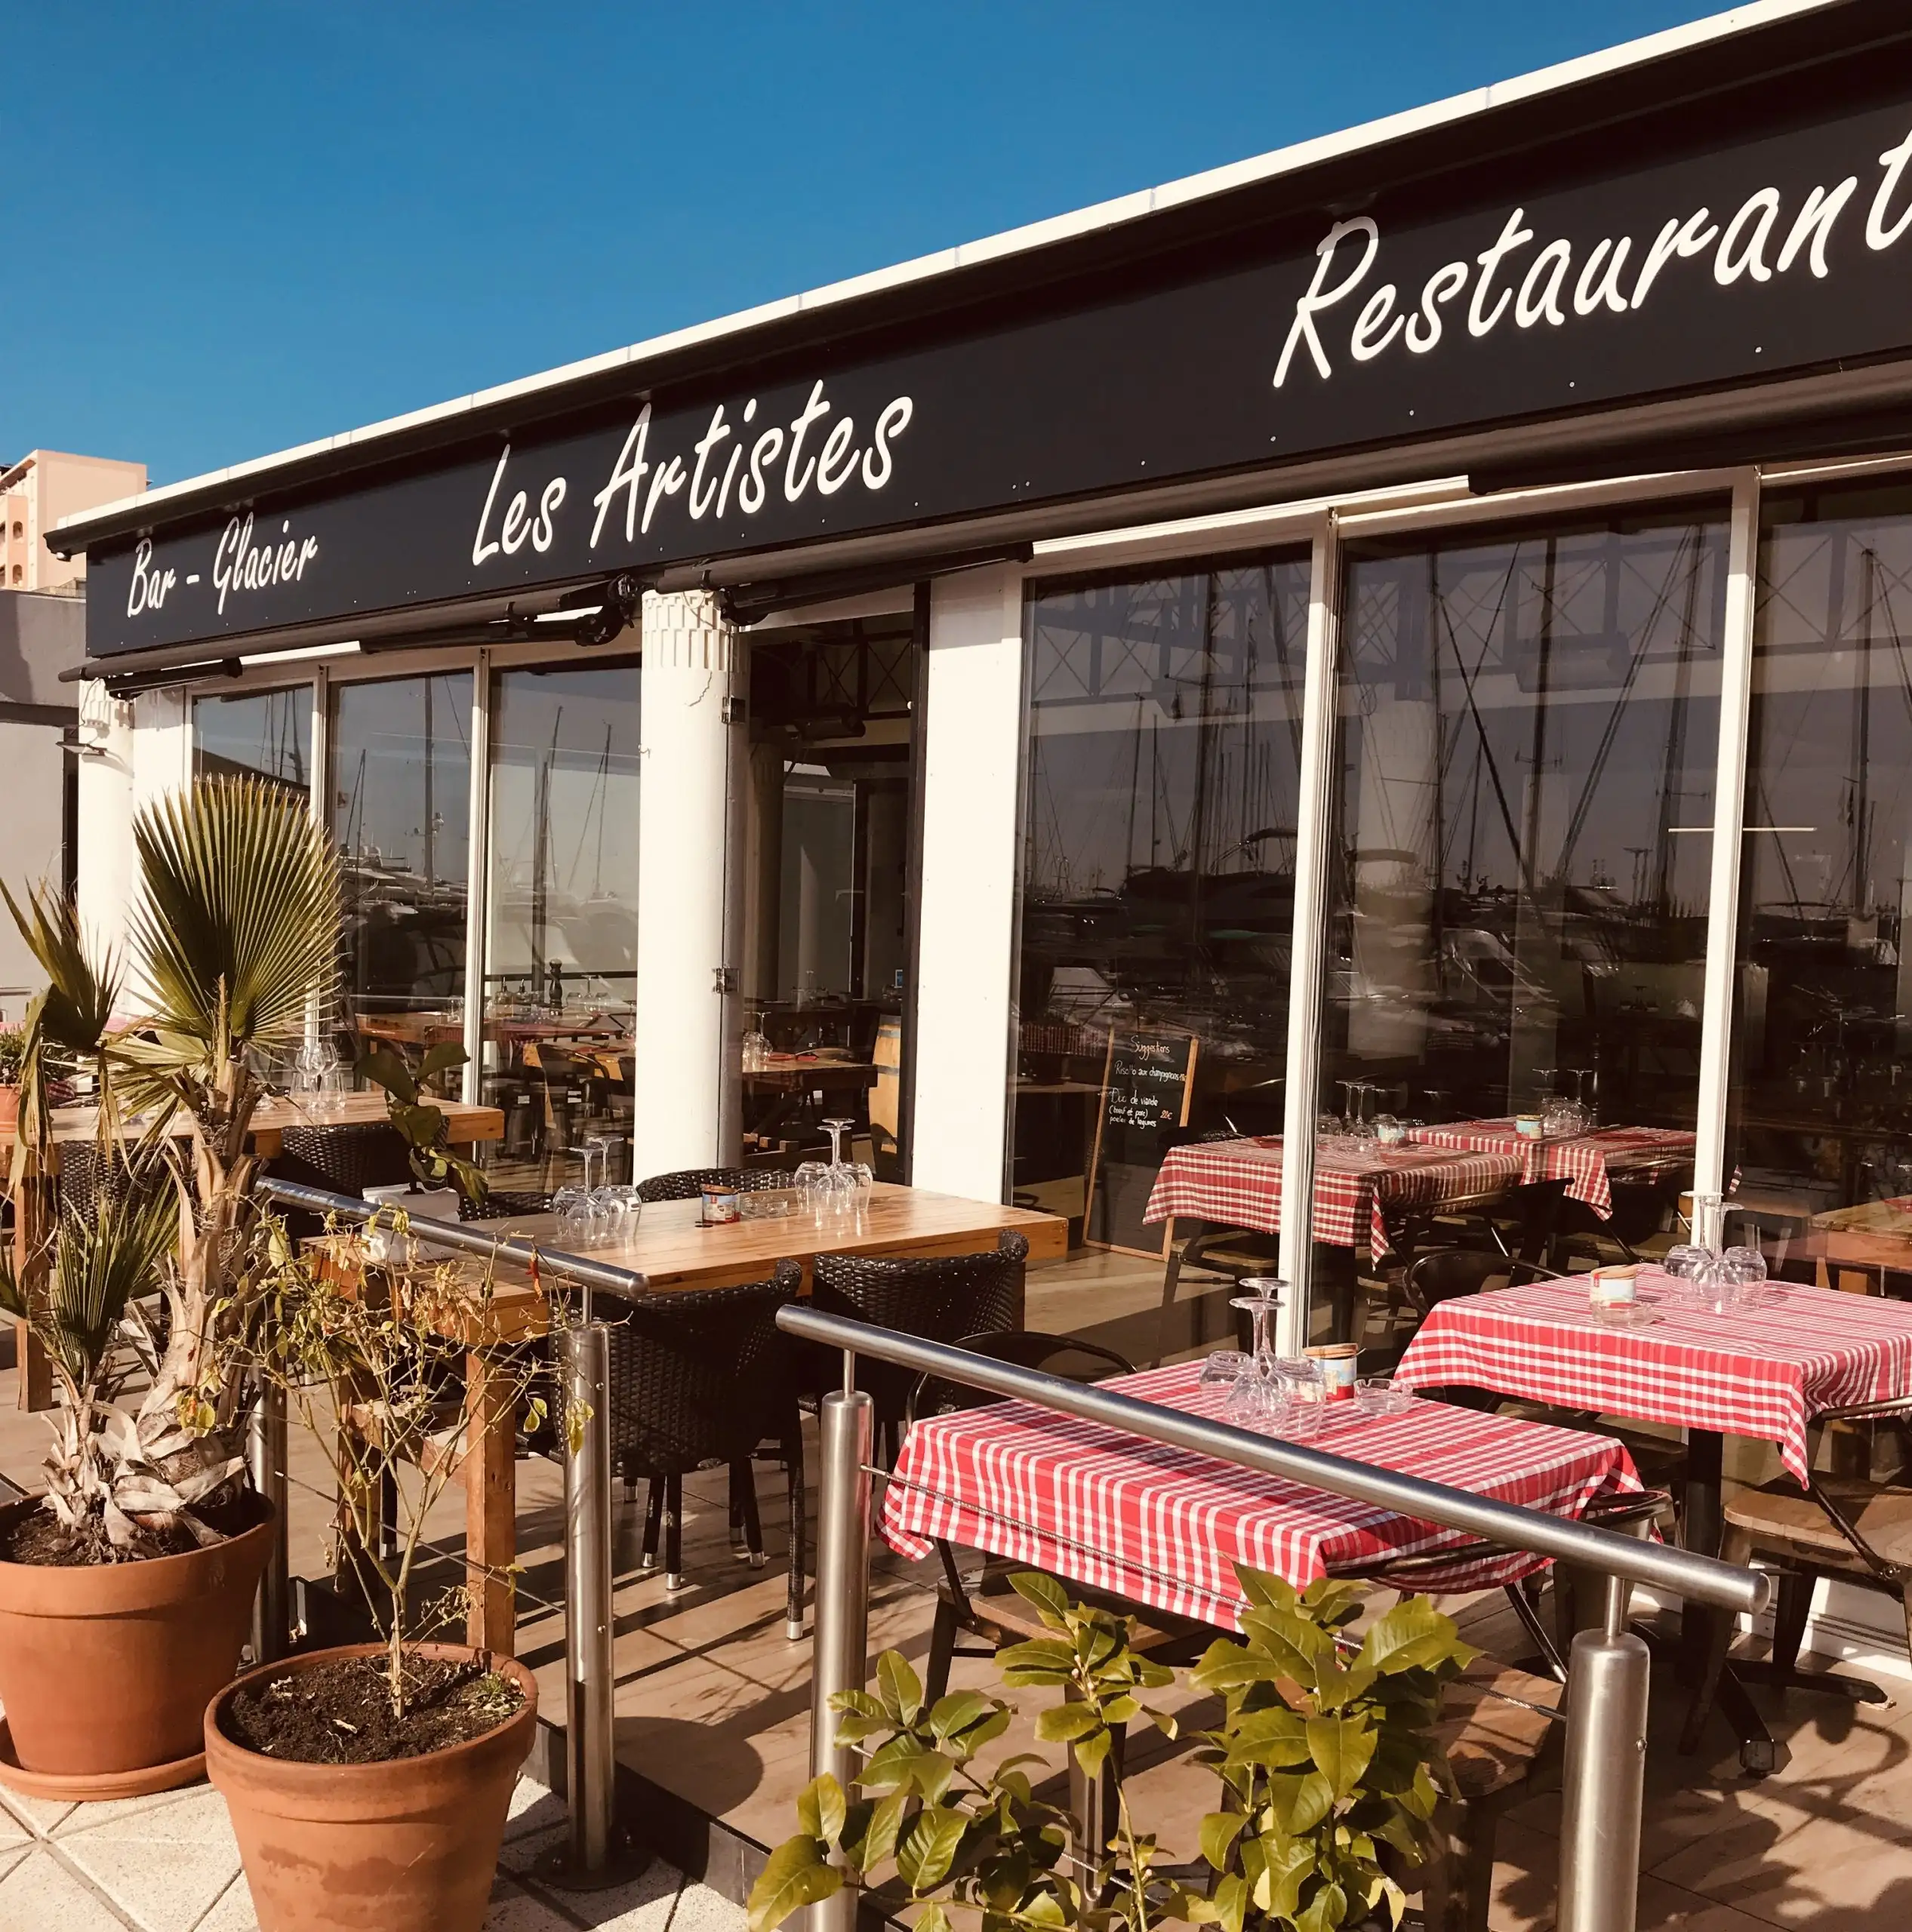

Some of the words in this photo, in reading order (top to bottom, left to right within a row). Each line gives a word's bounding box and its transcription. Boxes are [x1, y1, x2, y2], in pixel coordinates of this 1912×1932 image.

[1272, 129, 1912, 389] Restaurant
[472, 444, 567, 566] Les
[590, 379, 913, 549] Artistes
[127, 537, 177, 618] Bar
[213, 512, 319, 616] Glacier
[1130, 1090, 1138, 1105] de
